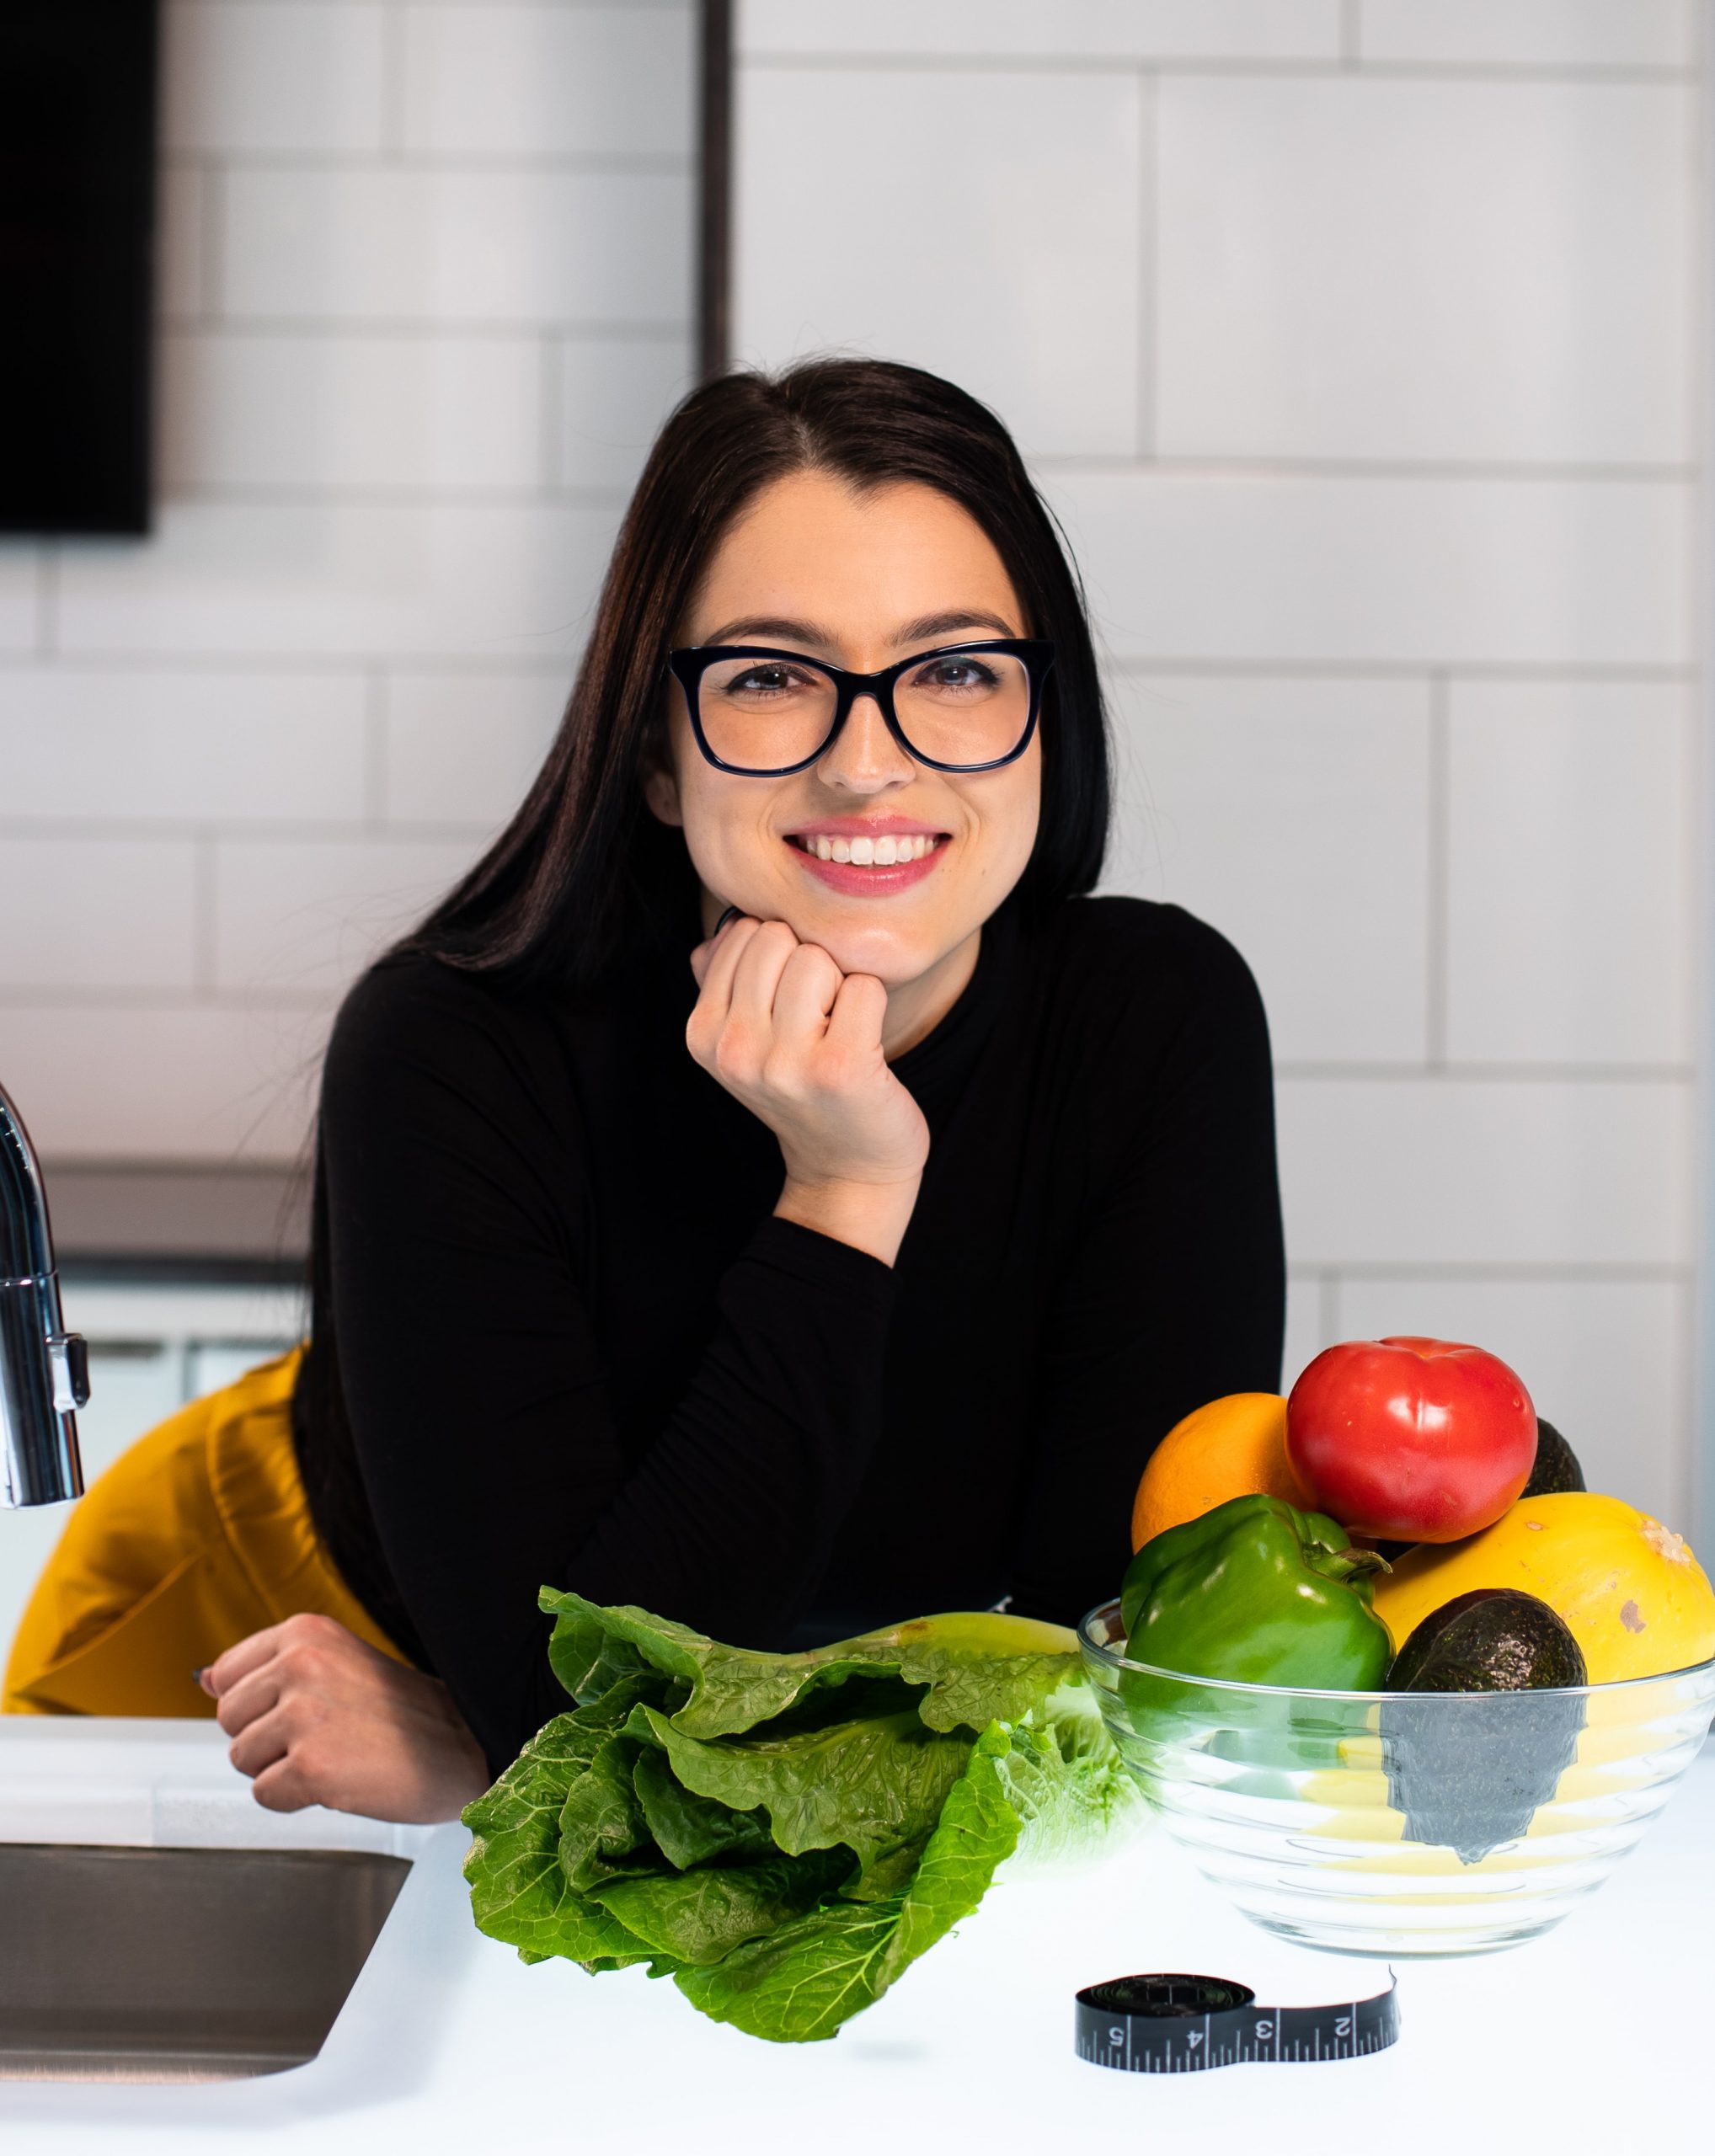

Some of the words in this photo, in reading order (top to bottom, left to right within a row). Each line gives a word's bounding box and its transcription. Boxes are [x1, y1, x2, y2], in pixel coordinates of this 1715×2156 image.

[1255, 2020, 1274, 2040] 3
[1335, 2017, 1351, 2036] 2
[1108, 2026, 1125, 2047] 5
[1186, 2031, 1204, 2049] 4
